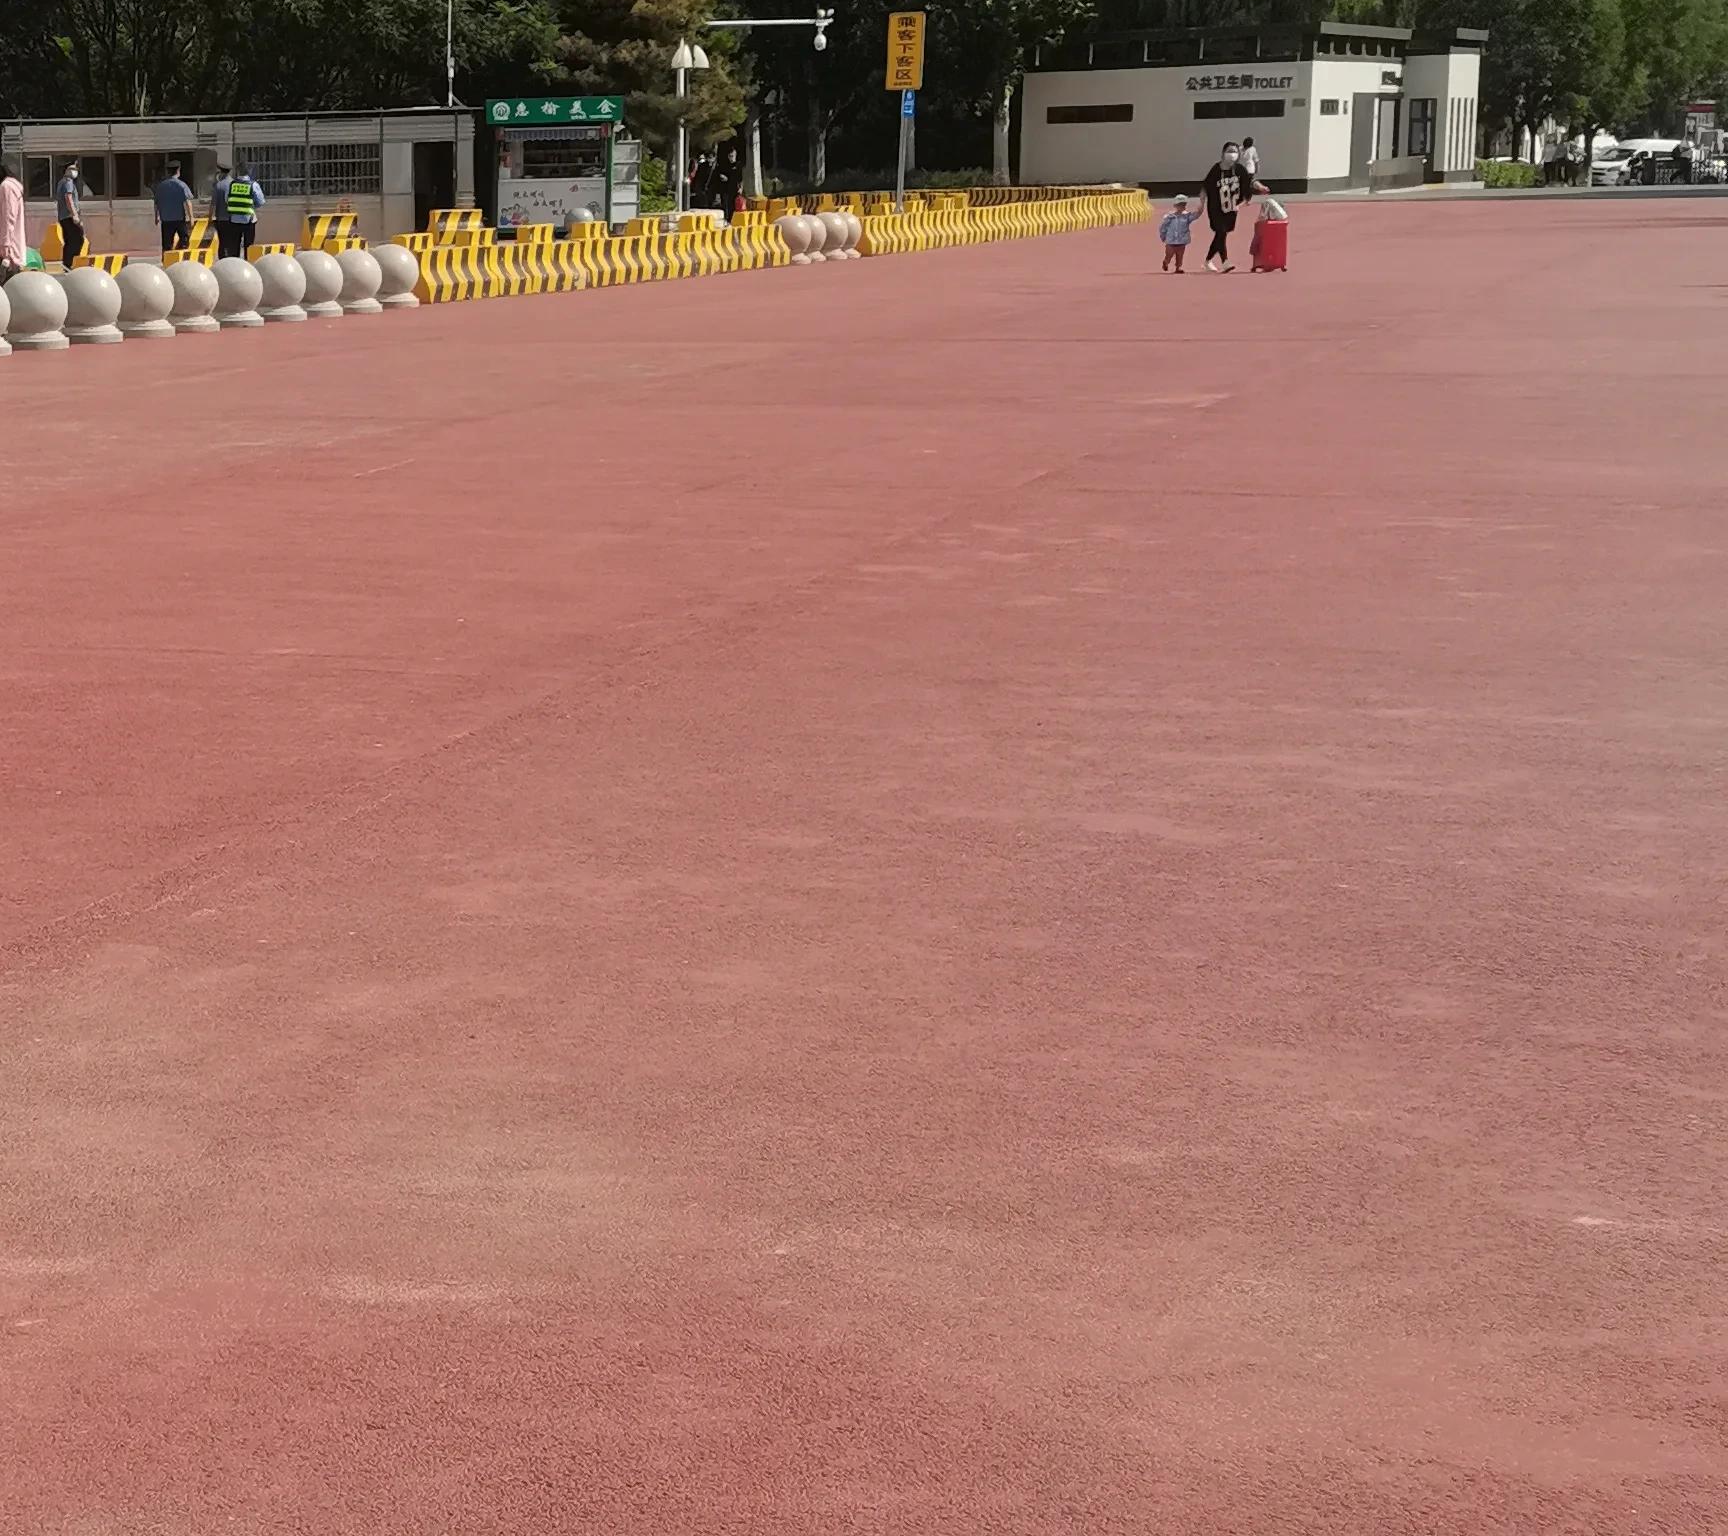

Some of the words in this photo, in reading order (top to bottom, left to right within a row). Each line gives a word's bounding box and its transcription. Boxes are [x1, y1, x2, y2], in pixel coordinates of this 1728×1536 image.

[895, 16, 916, 80] 乘客下客区
[1186, 74, 1253, 90] 公共卫生间
[1254, 76, 1293, 89] TOILET
